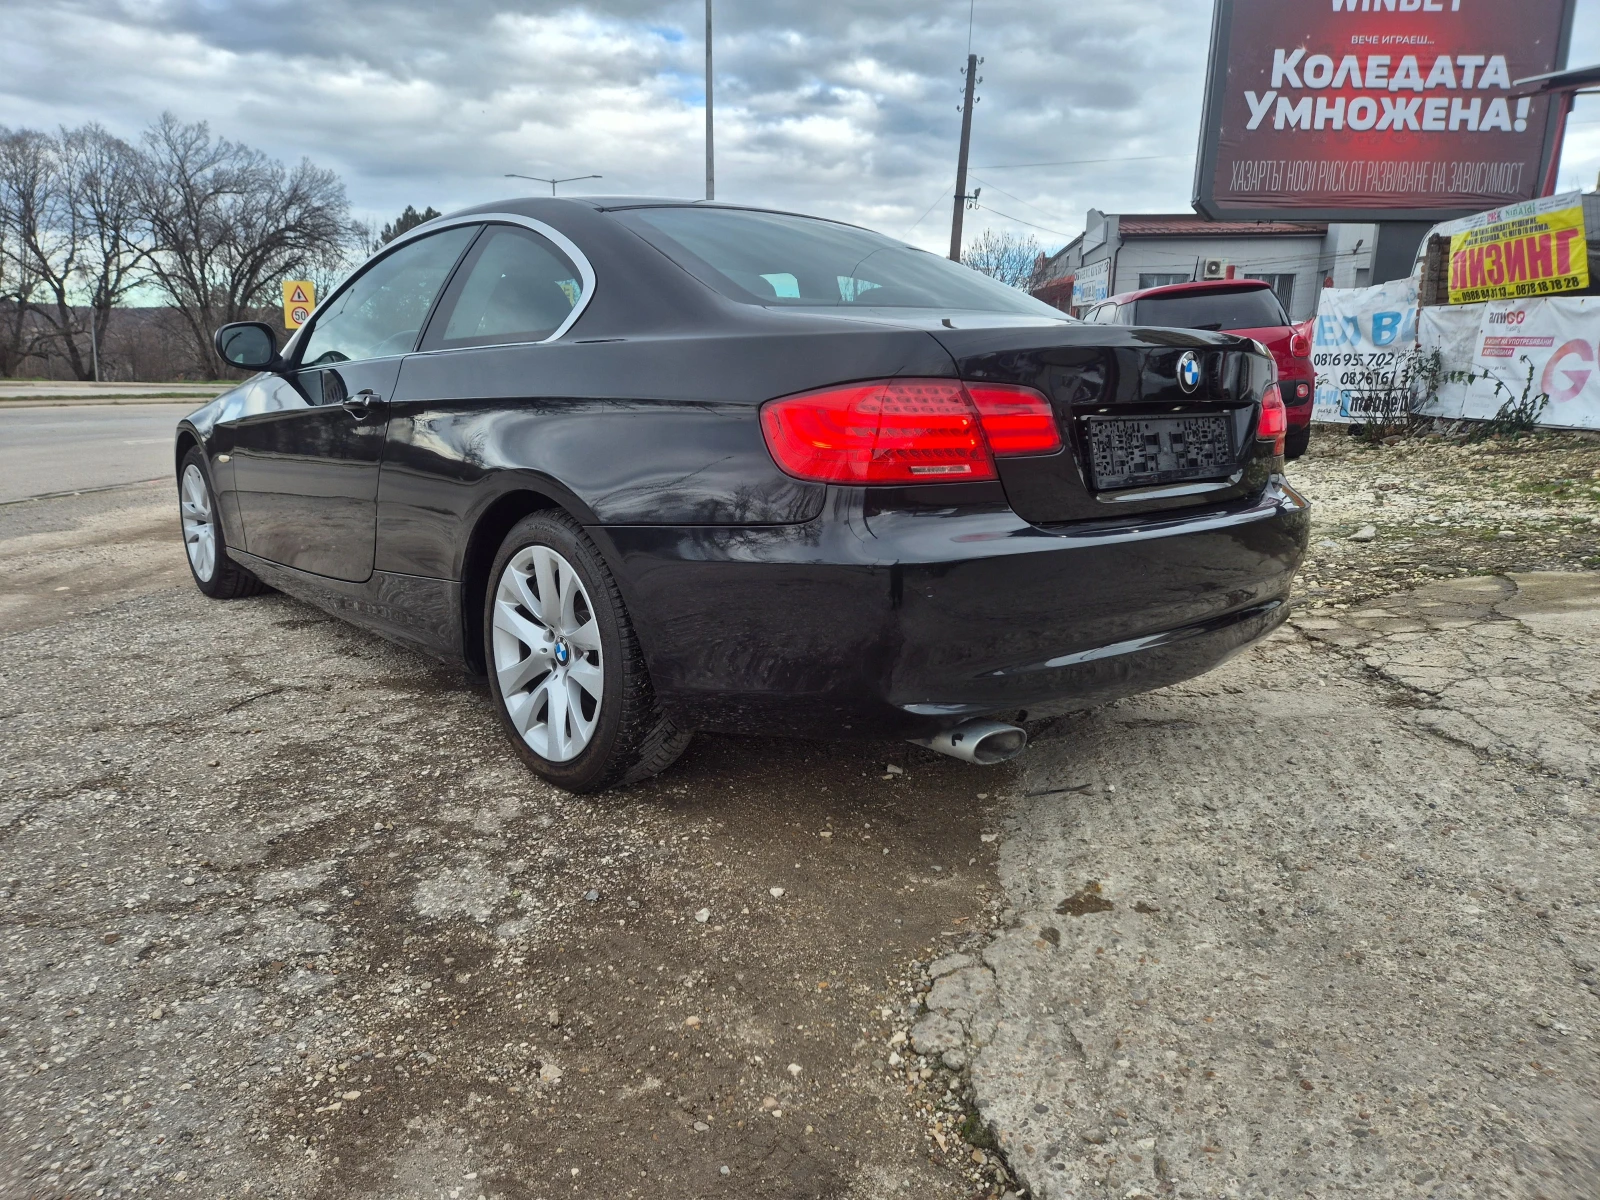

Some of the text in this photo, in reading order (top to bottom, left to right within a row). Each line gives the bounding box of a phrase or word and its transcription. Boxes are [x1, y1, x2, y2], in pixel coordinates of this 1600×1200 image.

[1351, 35, 1435, 45] ВЕЧЕ ИГРАЕШ...
[1270, 48, 1511, 92] КОЛЕДАТА
[1243, 90, 1531, 133] УМНОЖЕНА!
[1229, 160, 1525, 193] ХАЗАРТЪТ НОСИ РИСК ОТ РАЗВИВАНЕ НА ЗАВИСИМОСТ
[1450, 228, 1580, 291] ЛИЗИНГ
[1565, 276, 1580, 288] 28
[294, 310, 306, 321] 50
[1366, 352, 1395, 367] 702
